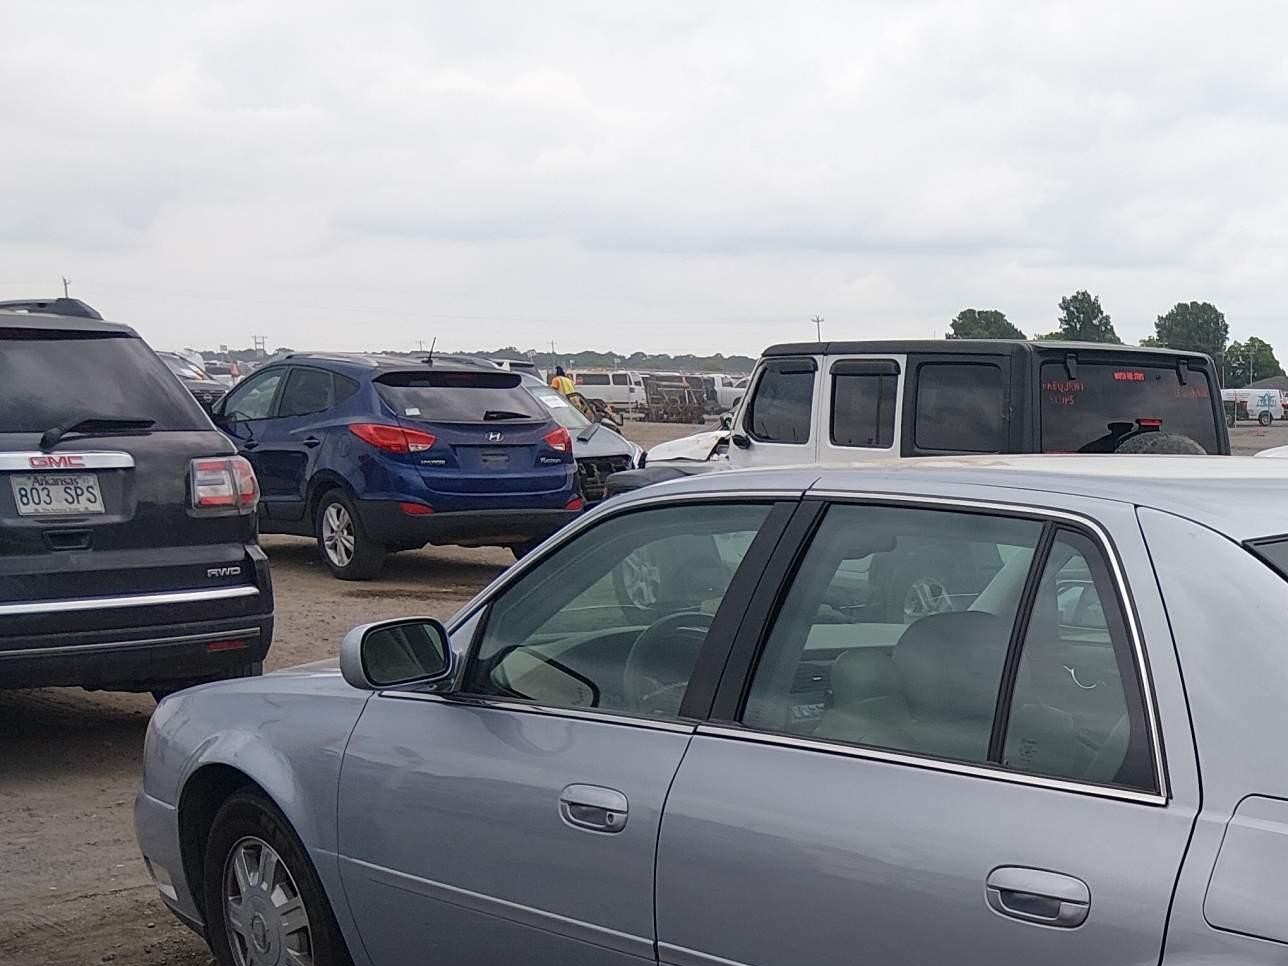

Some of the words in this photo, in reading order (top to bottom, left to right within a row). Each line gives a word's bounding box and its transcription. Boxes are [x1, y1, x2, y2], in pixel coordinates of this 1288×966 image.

[29, 455, 86, 469] GMC
[32, 475, 79, 487] Arkansas
[18, 487, 53, 506] 803
[63, 485, 98, 505] SPS
[207, 566, 241, 578] AWD
